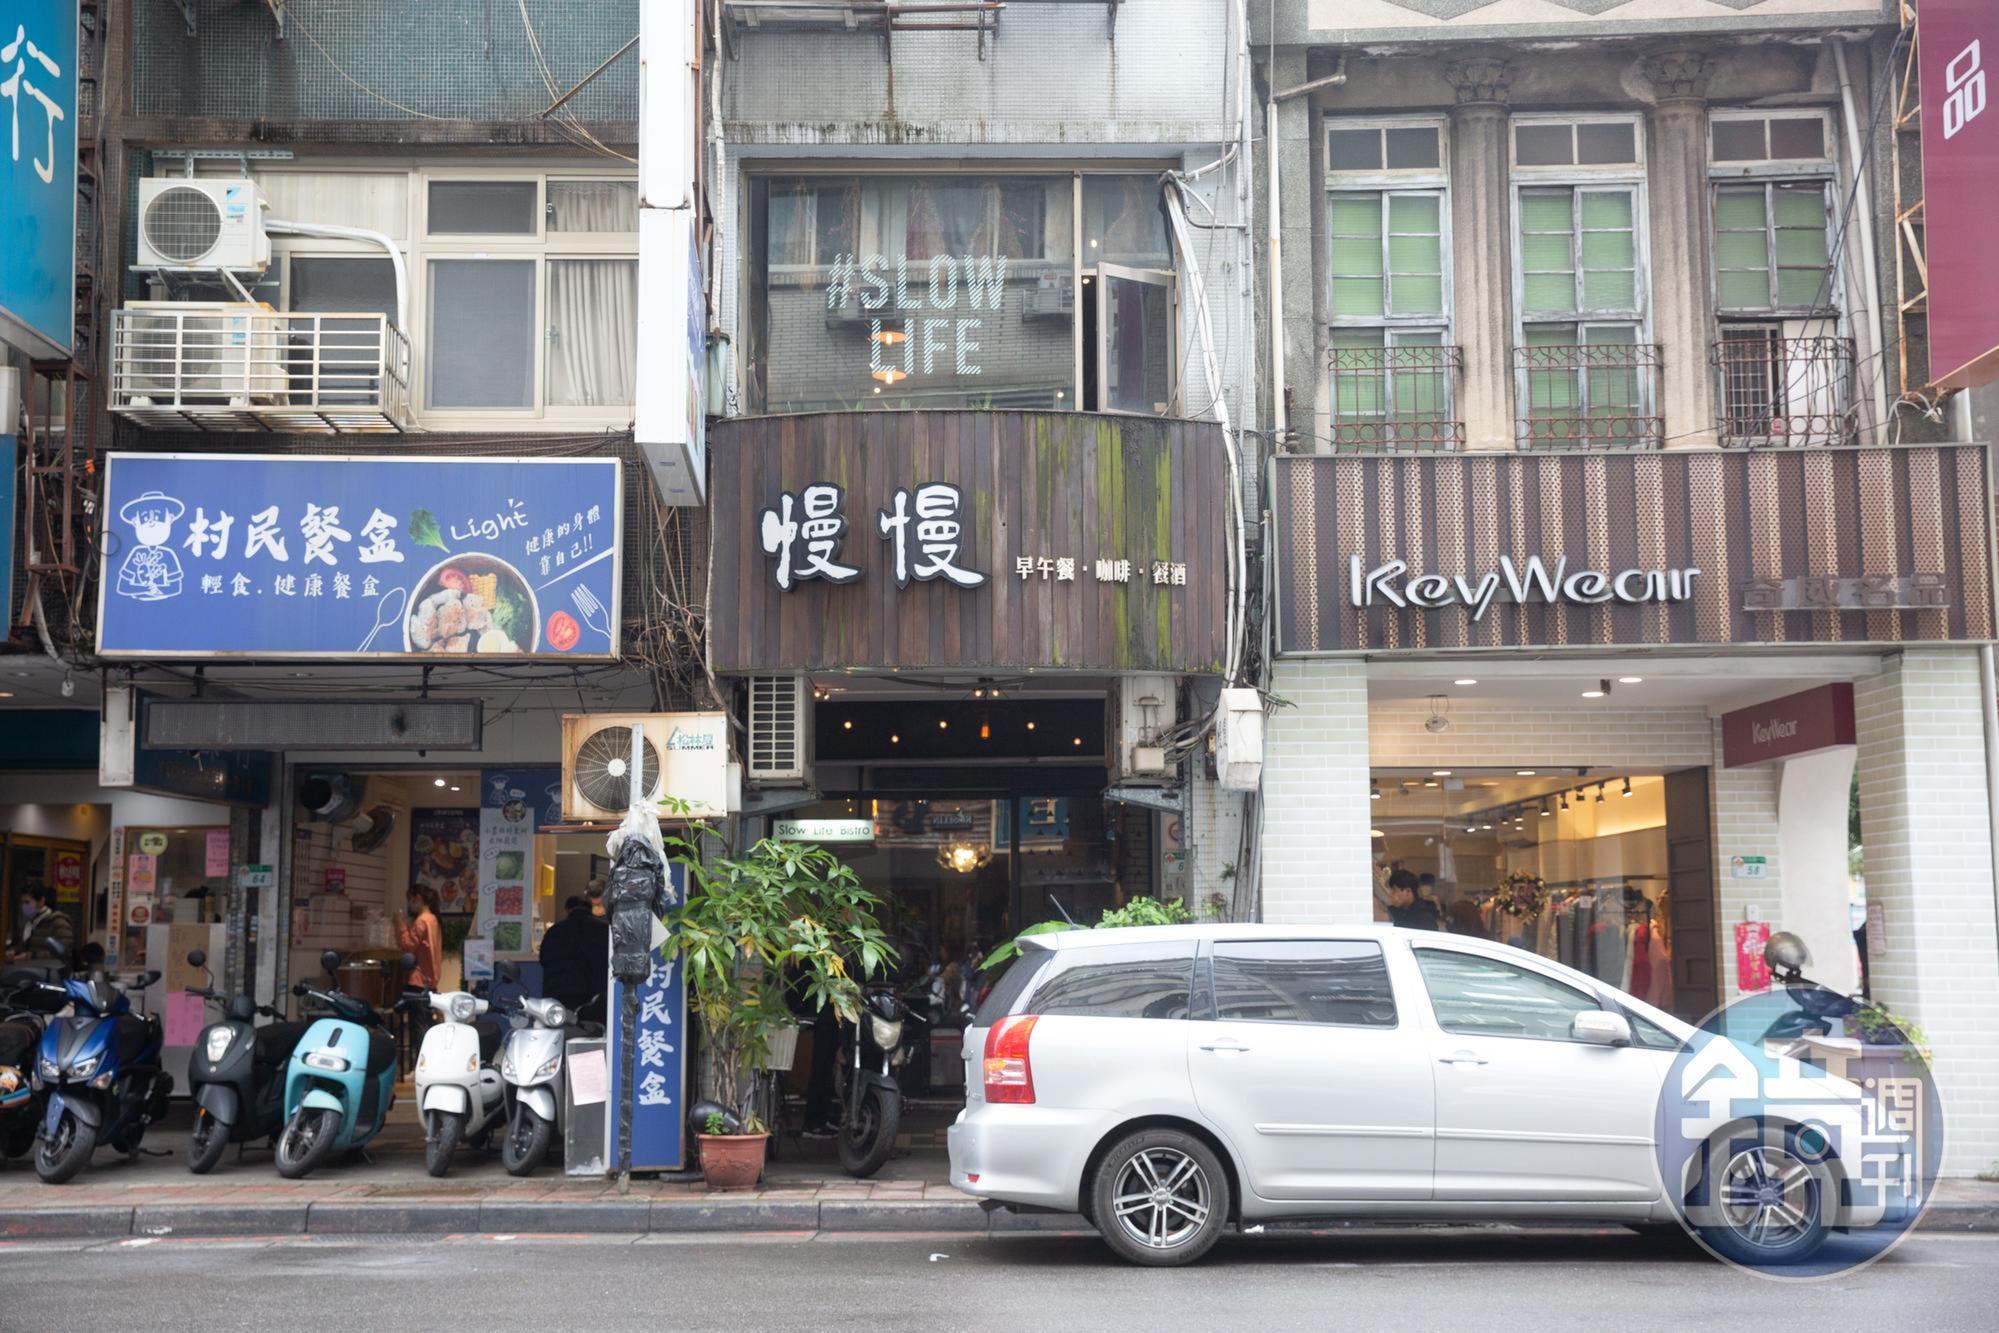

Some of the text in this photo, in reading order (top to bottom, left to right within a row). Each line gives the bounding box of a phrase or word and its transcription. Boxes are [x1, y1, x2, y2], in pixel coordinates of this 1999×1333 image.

[1, 23, 64, 184] 行
[1943, 38, 1986, 140] 品
[826, 253, 1008, 310] #SLOW
[871, 318, 982, 375] LIFE
[183, 502, 405, 566] 村民餐盒
[450, 510, 529, 541] Light
[525, 504, 601, 556] 健康的身體
[761, 484, 985, 590] 慢慢
[1351, 554, 1701, 622] KeyWear
[1751, 719, 1798, 747] KeyWear
[778, 824, 806, 836] Slow
[840, 825, 870, 836] Bistro
[252, 874, 266, 884] 64
[637, 958, 674, 1105] 村民餐盒
